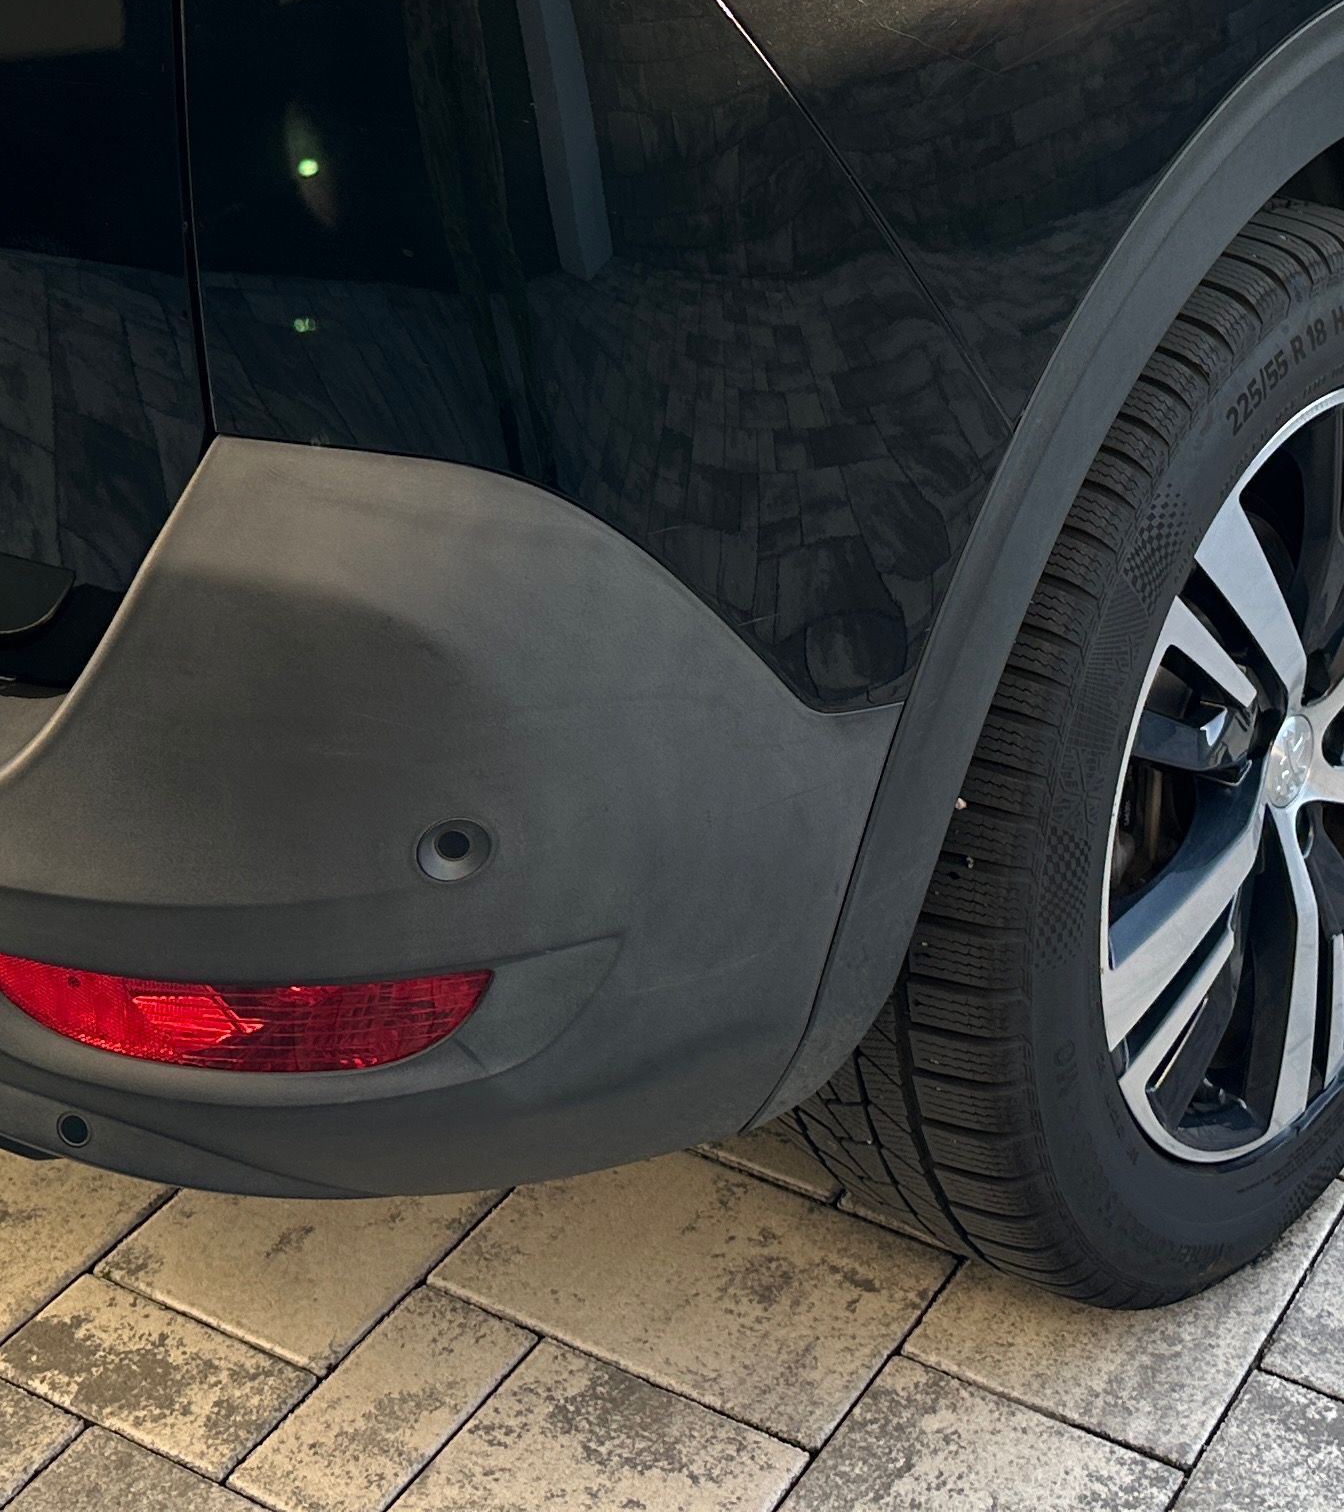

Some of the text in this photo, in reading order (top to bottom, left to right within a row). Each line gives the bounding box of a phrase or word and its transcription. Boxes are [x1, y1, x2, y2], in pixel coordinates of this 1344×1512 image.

[1225, 349, 1289, 436] 225/55
[1290, 334, 1306, 365] R
[1306, 317, 1328, 351] 18
